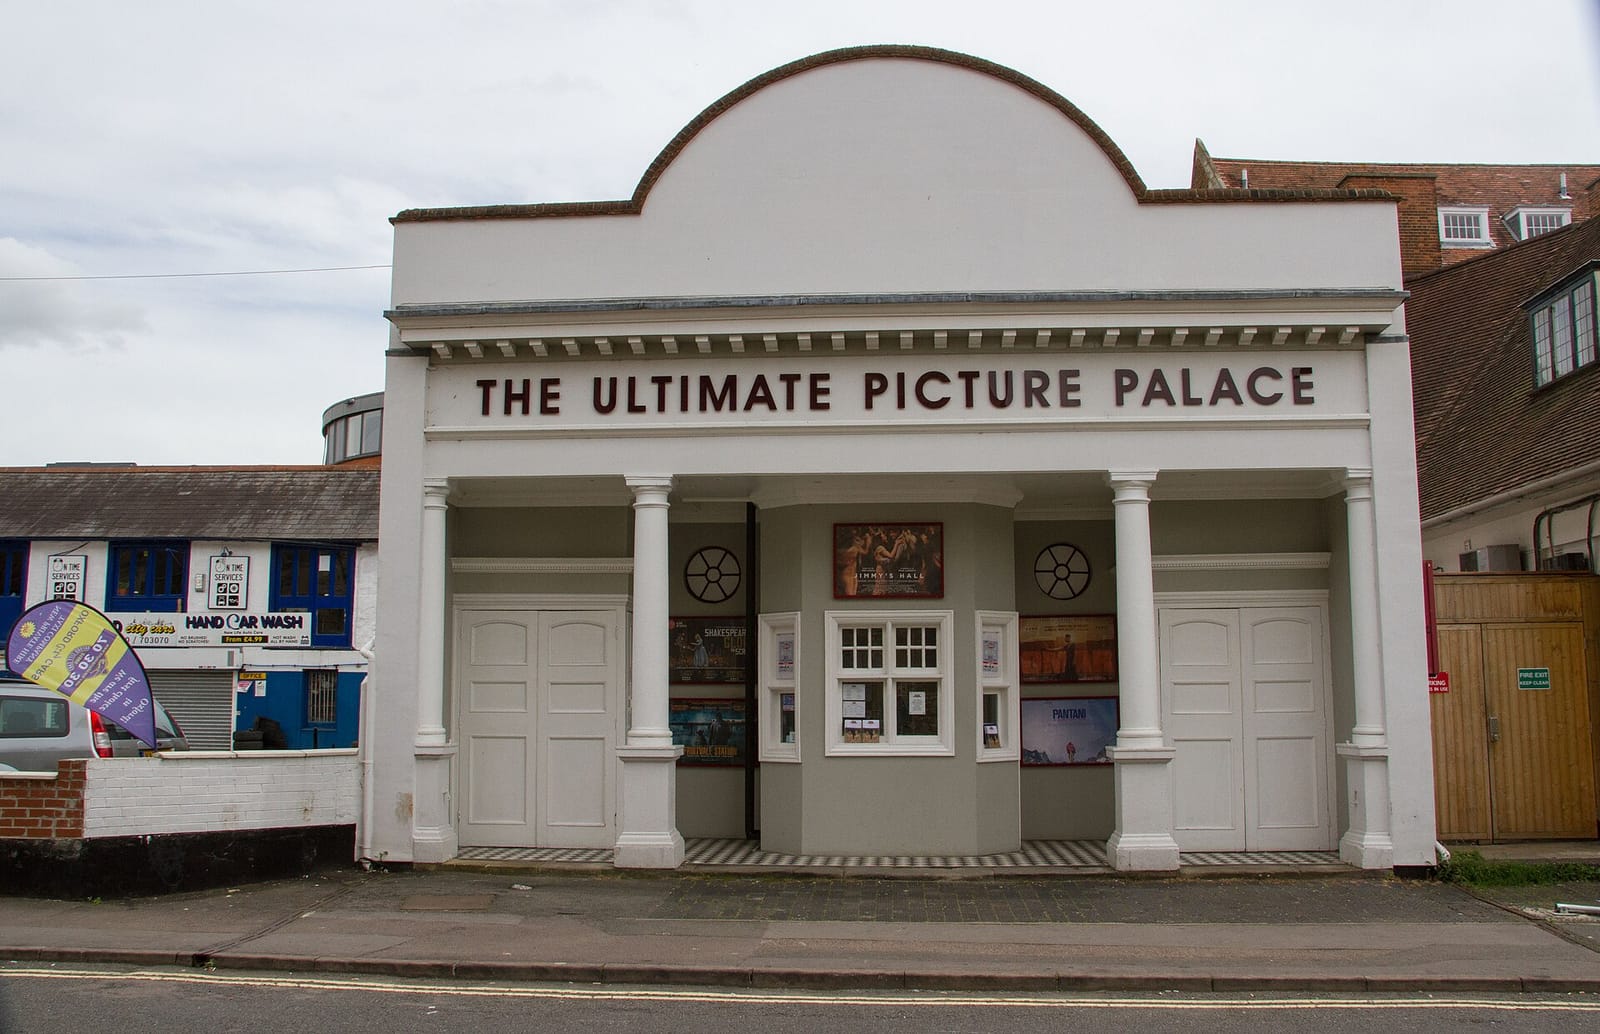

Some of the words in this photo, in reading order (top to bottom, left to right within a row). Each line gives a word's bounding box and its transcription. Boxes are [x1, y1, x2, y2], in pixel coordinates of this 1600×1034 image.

[477, 377, 561, 415] THE
[593, 373, 831, 414] ULTIMATE
[864, 369, 1081, 410] PICTURE
[1114, 366, 1315, 407] PALACE
[52, 572, 80, 580] SERVICES
[214, 573, 243, 581] SERVICES
[186, 616, 225, 629] HAND
[226, 613, 258, 630] CAR
[260, 616, 303, 629] WASH
[126, 624, 148, 636] city
[150, 625, 175, 634] cars
[140, 636, 169, 644] 703070
[1052, 708, 1086, 719] PANTANI
